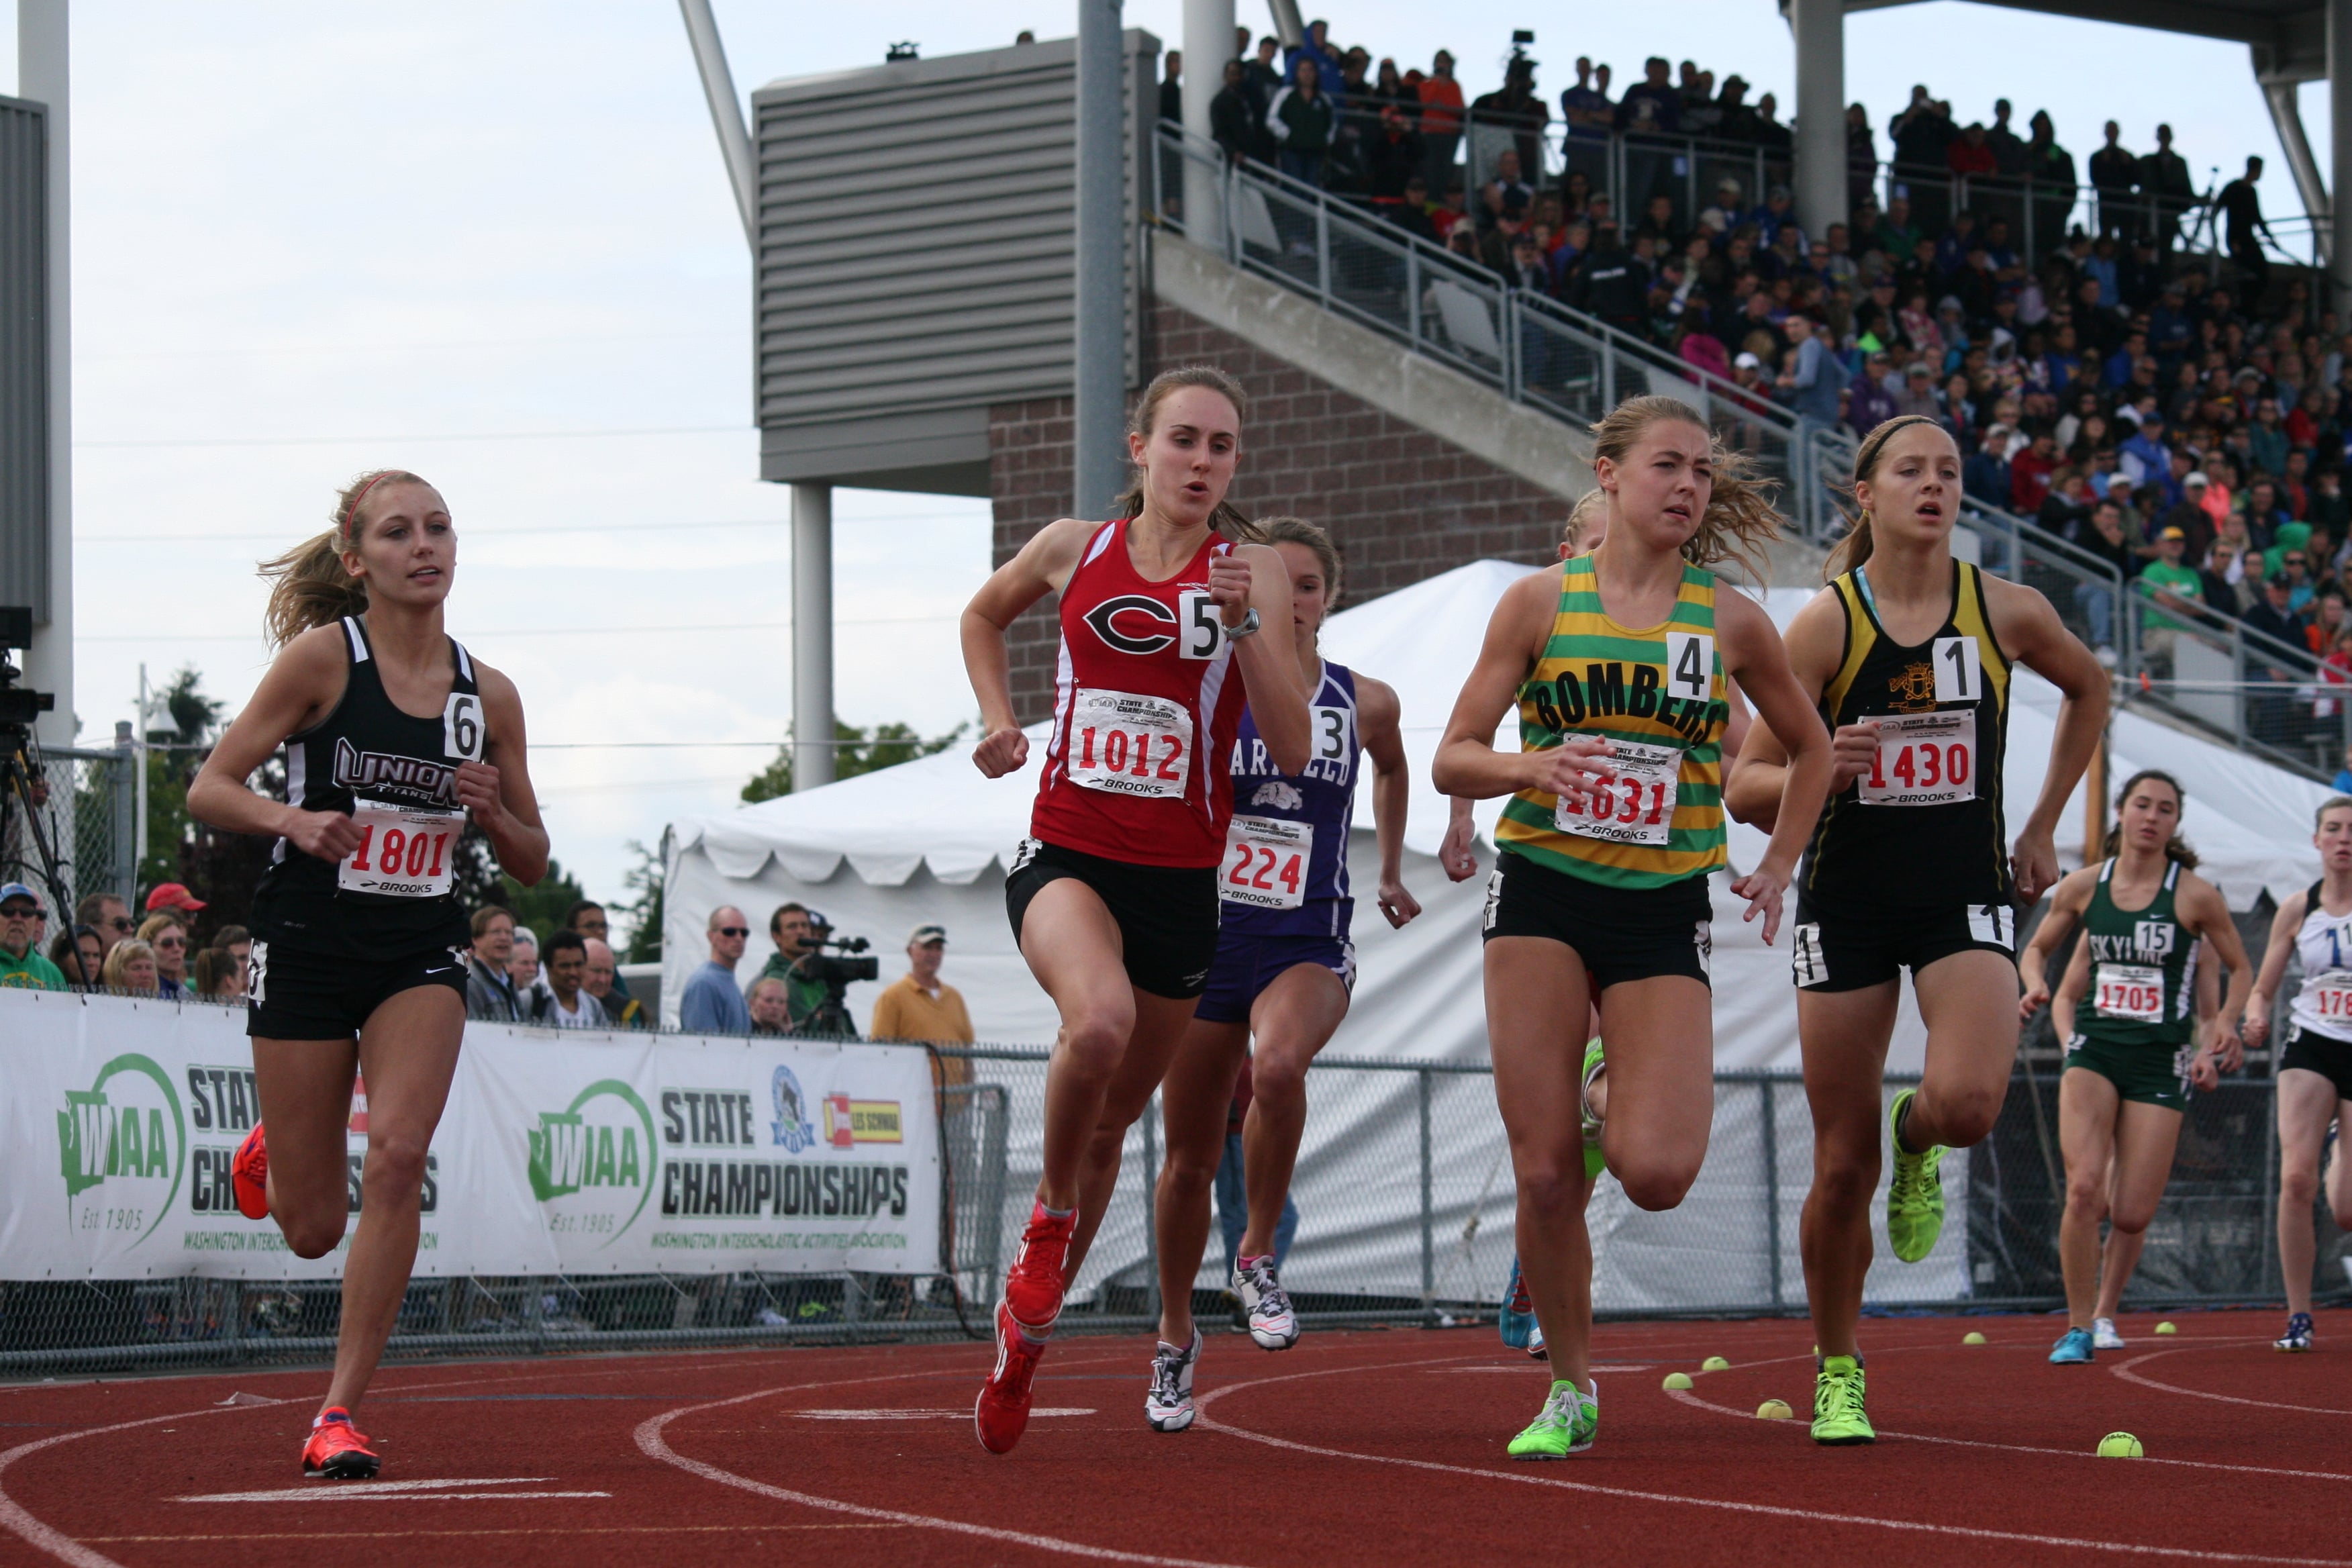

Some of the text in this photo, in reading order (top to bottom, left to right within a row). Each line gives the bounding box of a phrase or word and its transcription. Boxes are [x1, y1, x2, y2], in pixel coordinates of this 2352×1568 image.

[1082, 594, 1176, 655] C
[1193, 597, 1219, 657] 5
[1675, 637, 1705, 695] 4
[1945, 640, 1968, 696] 1
[1117, 705, 1177, 720] CHAMPIONSHIPS
[1120, 699, 1142, 707] STATE
[1535, 662, 1720, 748] BOMBERS
[452, 698, 477, 756] 6
[1321, 709, 1342, 759] 3
[334, 738, 464, 808] UNION
[1079, 726, 1183, 781] 1012
[1614, 747, 1632, 755] TATE
[1868, 742, 1969, 788] 1430
[377, 785, 430, 800] TITANS
[1105, 779, 1165, 794] BROOKS
[1898, 791, 1956, 803] BROOKS
[1244, 826, 1300, 839] CHAMPIONSHIPS
[1247, 820, 1267, 828] STATE
[1591, 825, 1649, 840] BROOKS
[351, 824, 449, 877] 1801
[1220, 843, 1302, 894] 224
[379, 881, 432, 893] BROOKS
[1230, 890, 1283, 906] BROOKS
[1981, 905, 2003, 941] 1
[2142, 924, 2167, 950] 15
[1800, 927, 1814, 981] 1
[2100, 984, 2159, 1012] 1705
[188, 1067, 262, 1129] STAT
[661, 1090, 753, 1145] STATE
[77, 1102, 169, 1178] WIAA
[550, 1123, 640, 1187] WIAA
[661, 1161, 908, 1218] CHAMPIONSHIPS
[105, 1208, 144, 1231] 1905
[183, 1230, 246, 1251] WASHINGTON
[581, 1214, 615, 1234] 1905
